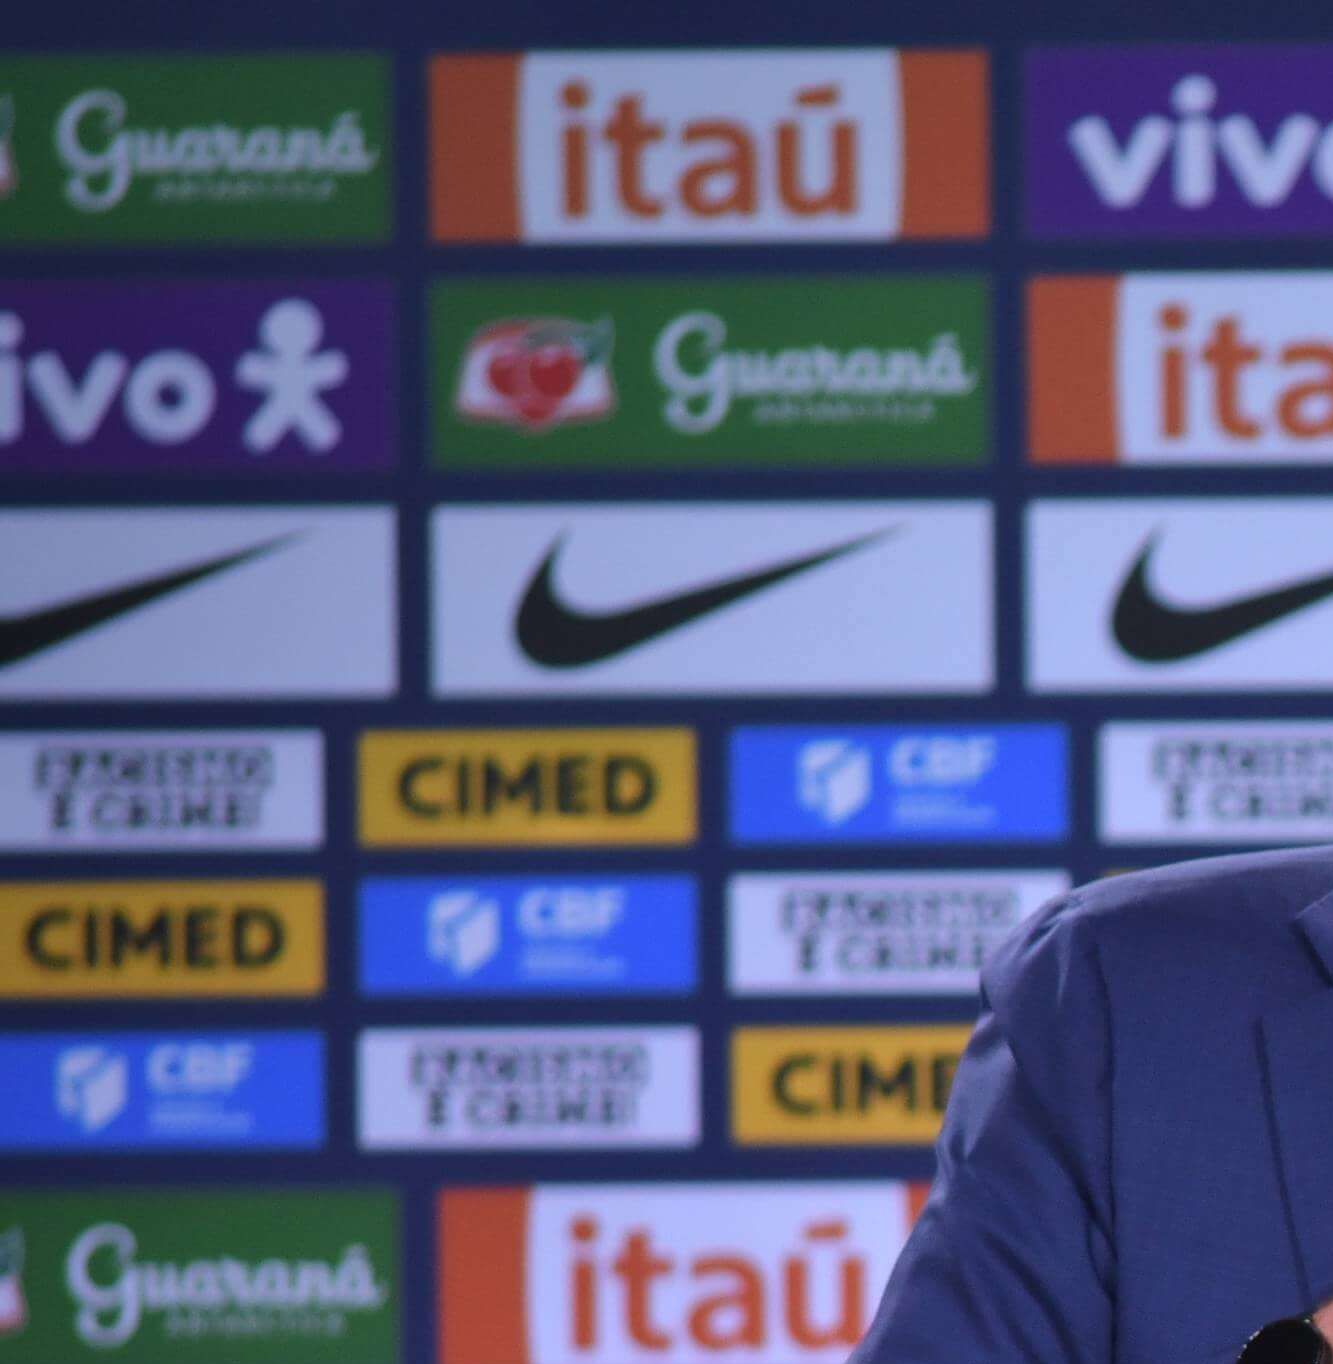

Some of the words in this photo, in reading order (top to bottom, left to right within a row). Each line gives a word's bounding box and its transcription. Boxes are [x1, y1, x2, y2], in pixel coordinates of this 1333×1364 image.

[56, 89, 380, 212] Guaraná
[560, 81, 861, 221] itaú
[0, 312, 216, 443] ivo
[653, 311, 976, 433] Guaraná
[395, 754, 657, 820] CIMED
[22, 906, 286, 973] CIMED
[771, 1050, 963, 1117] CIM
[66, 1223, 387, 1348] Guaraná
[570, 1217, 868, 1350] itaú
